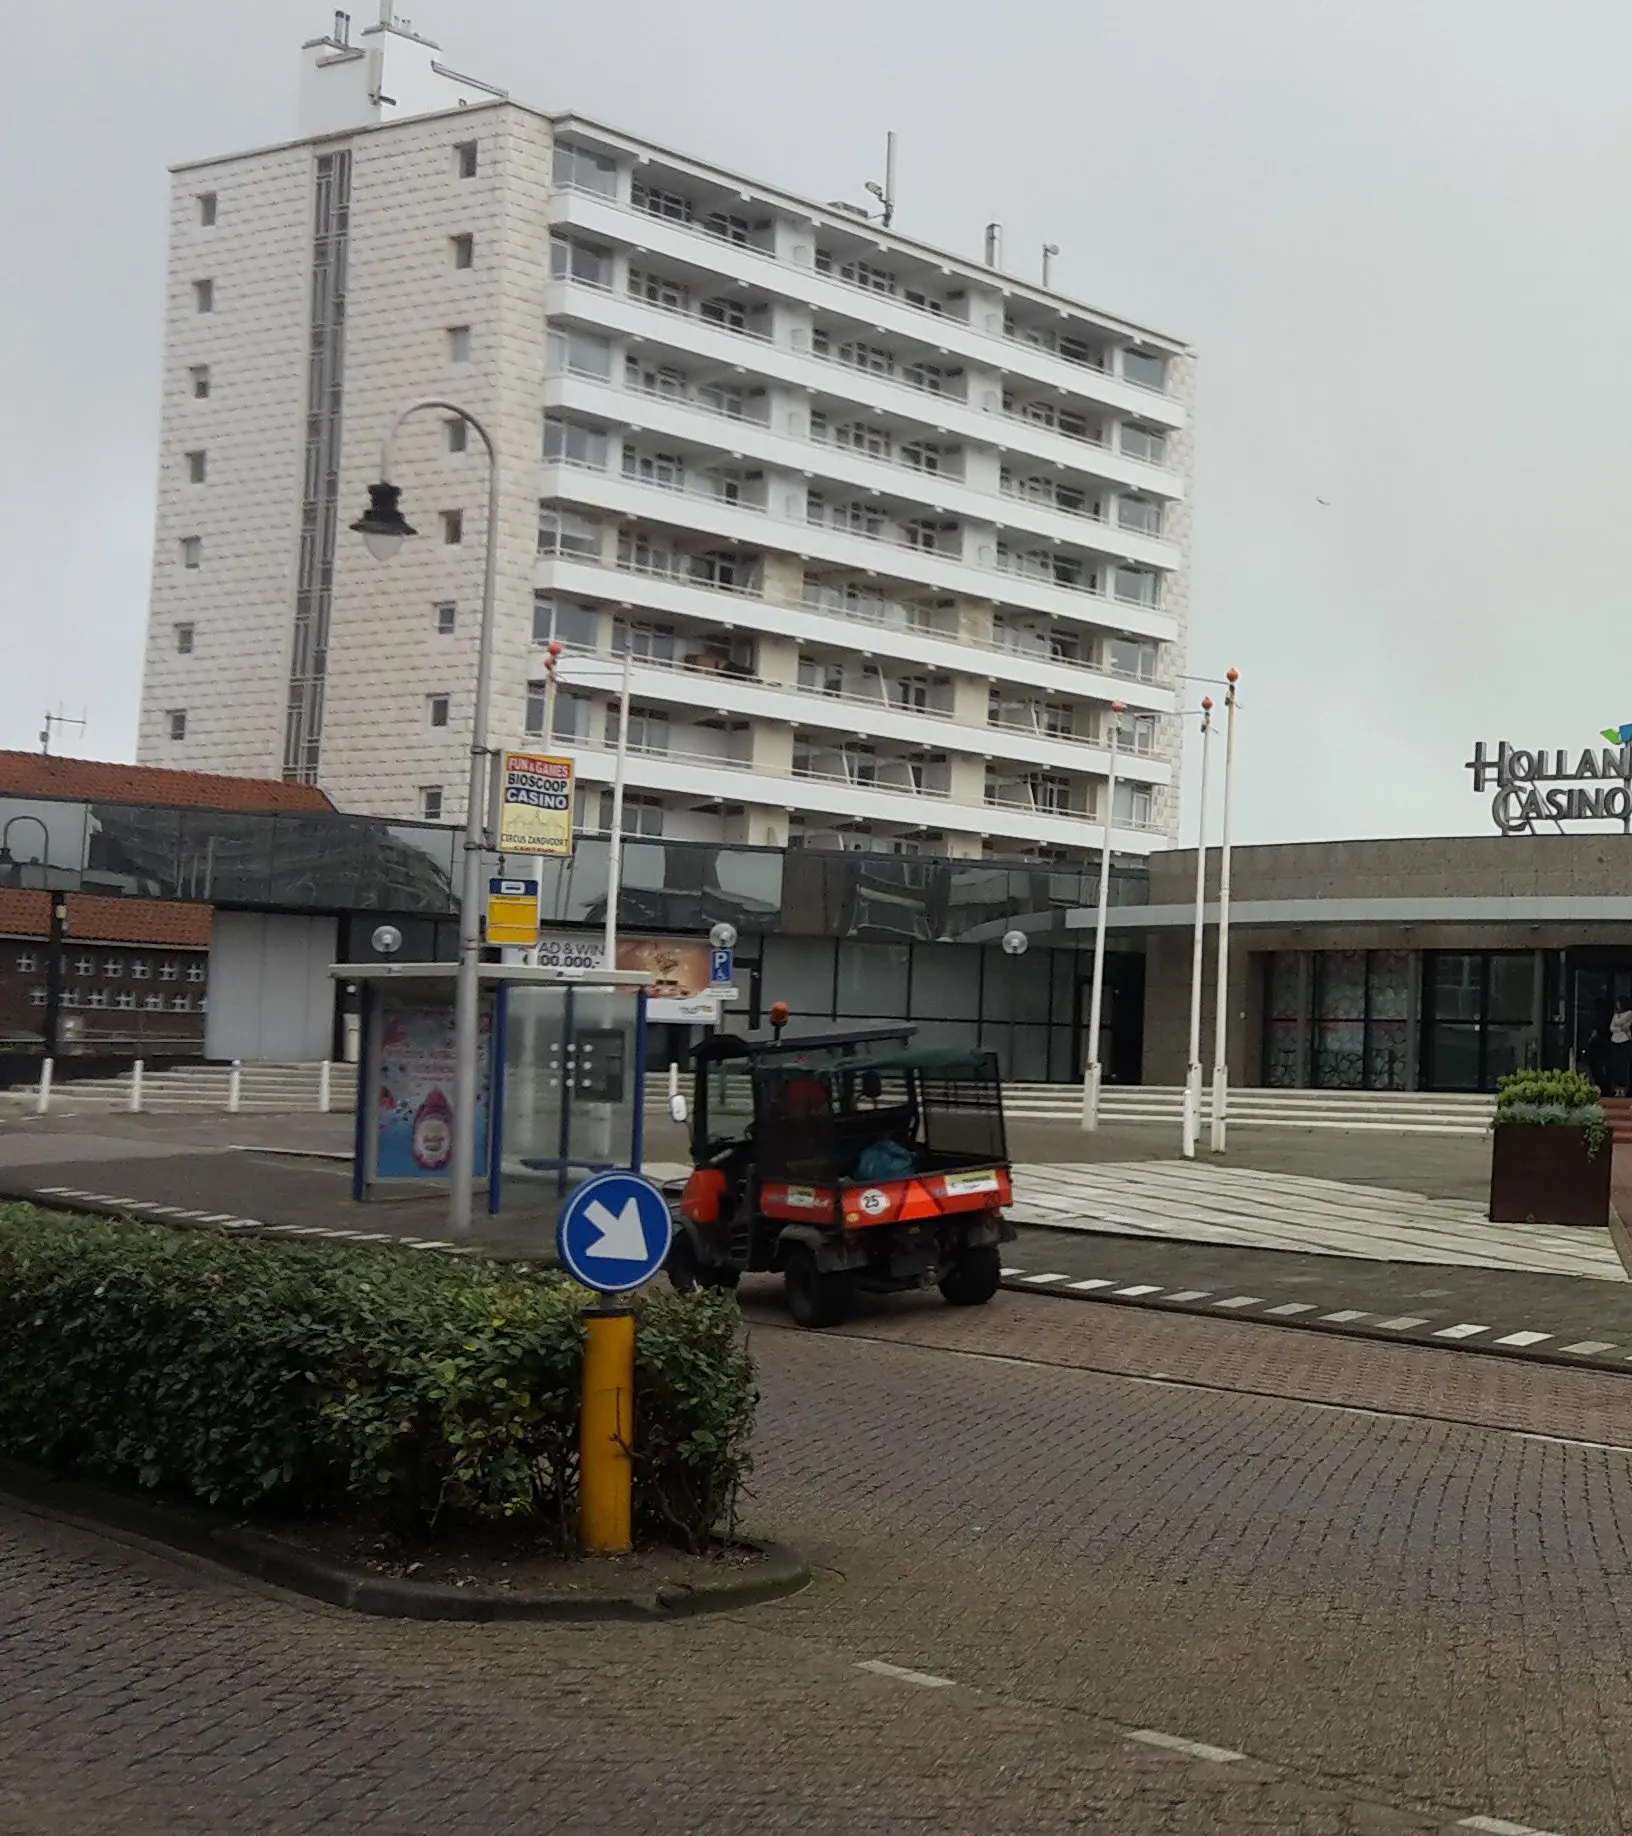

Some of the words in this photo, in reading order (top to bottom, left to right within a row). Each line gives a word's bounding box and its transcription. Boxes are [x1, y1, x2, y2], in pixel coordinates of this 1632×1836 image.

[508, 773, 567, 793] BIOSCOOP
[506, 788, 567, 810] CASINO
[575, 943, 606, 957] WIN
[715, 952, 728, 969] P
[863, 1194, 880, 1209] 25
